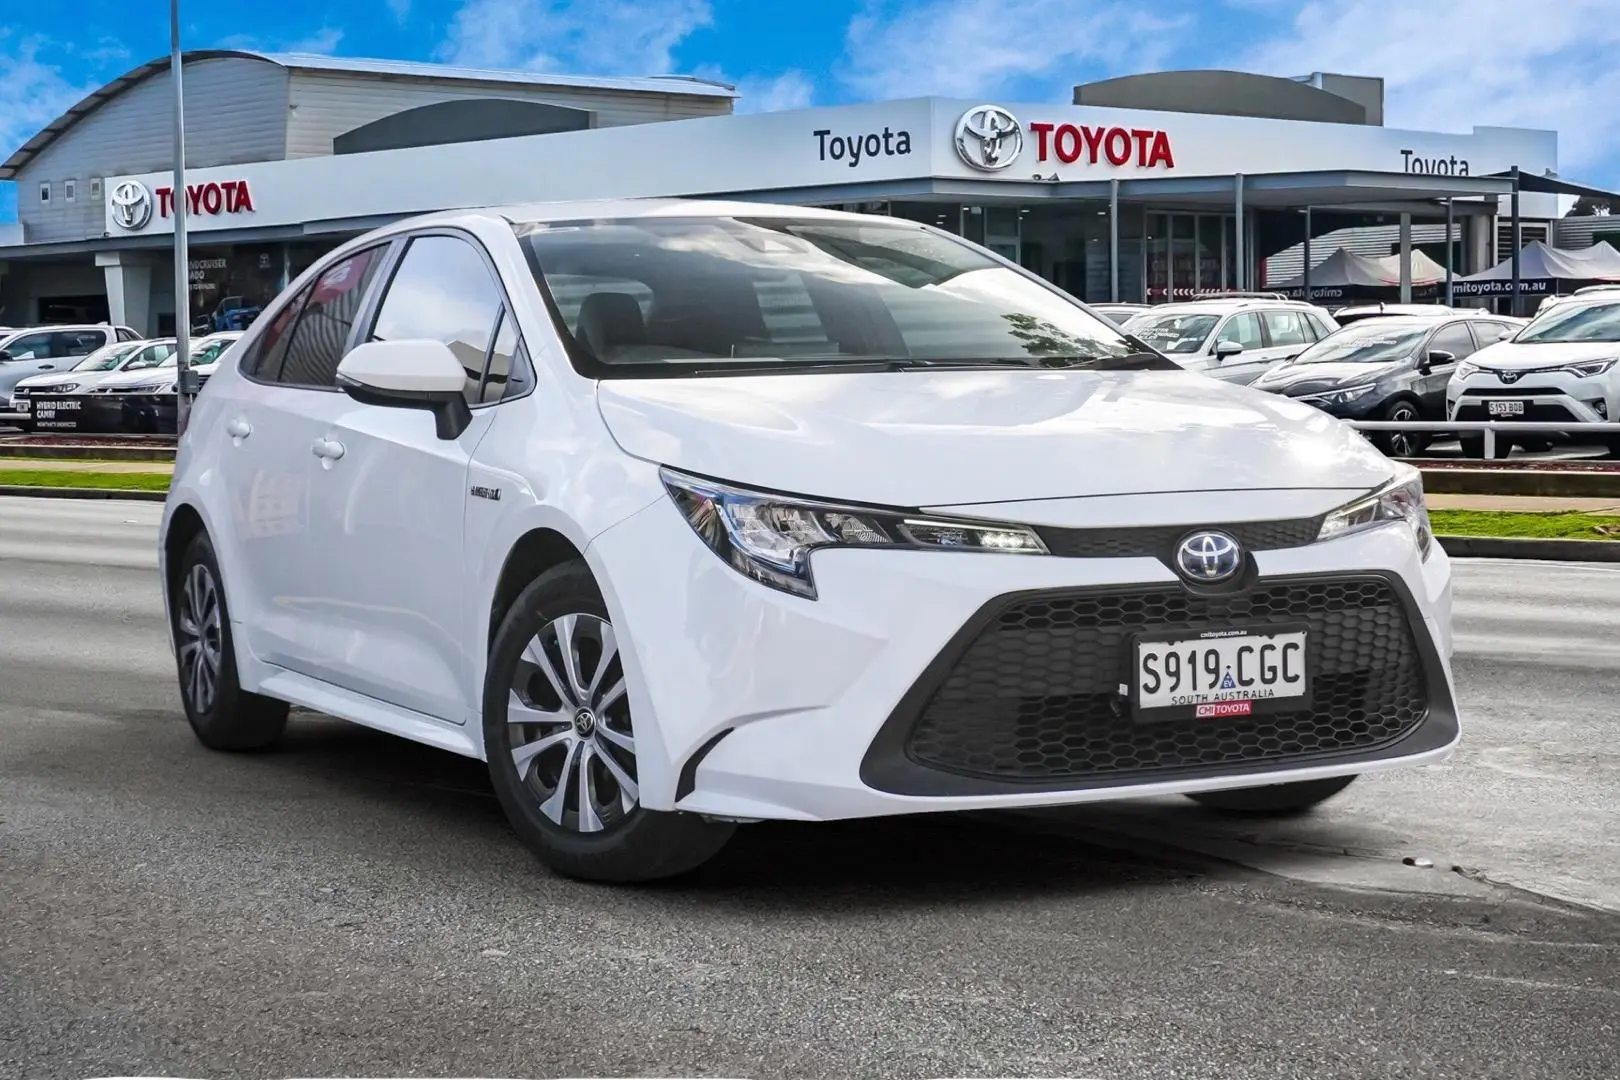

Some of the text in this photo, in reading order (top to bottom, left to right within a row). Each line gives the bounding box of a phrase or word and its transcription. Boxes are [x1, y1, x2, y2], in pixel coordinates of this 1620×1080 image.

[813, 127, 912, 167] Toyota
[1030, 122, 1174, 169] TOYOTA
[188, 258, 227, 270] NDCRUISER
[188, 270, 205, 280] ADO
[1452, 281, 1547, 295] mitoyota.cm.au
[36, 401, 81, 410] HYBRID ELECTRIC
[1142, 642, 1300, 694] S919 CGC
[1171, 688, 1275, 705] SOUTH AUSTRALIA
[1215, 703, 1250, 714] TOYOTA
